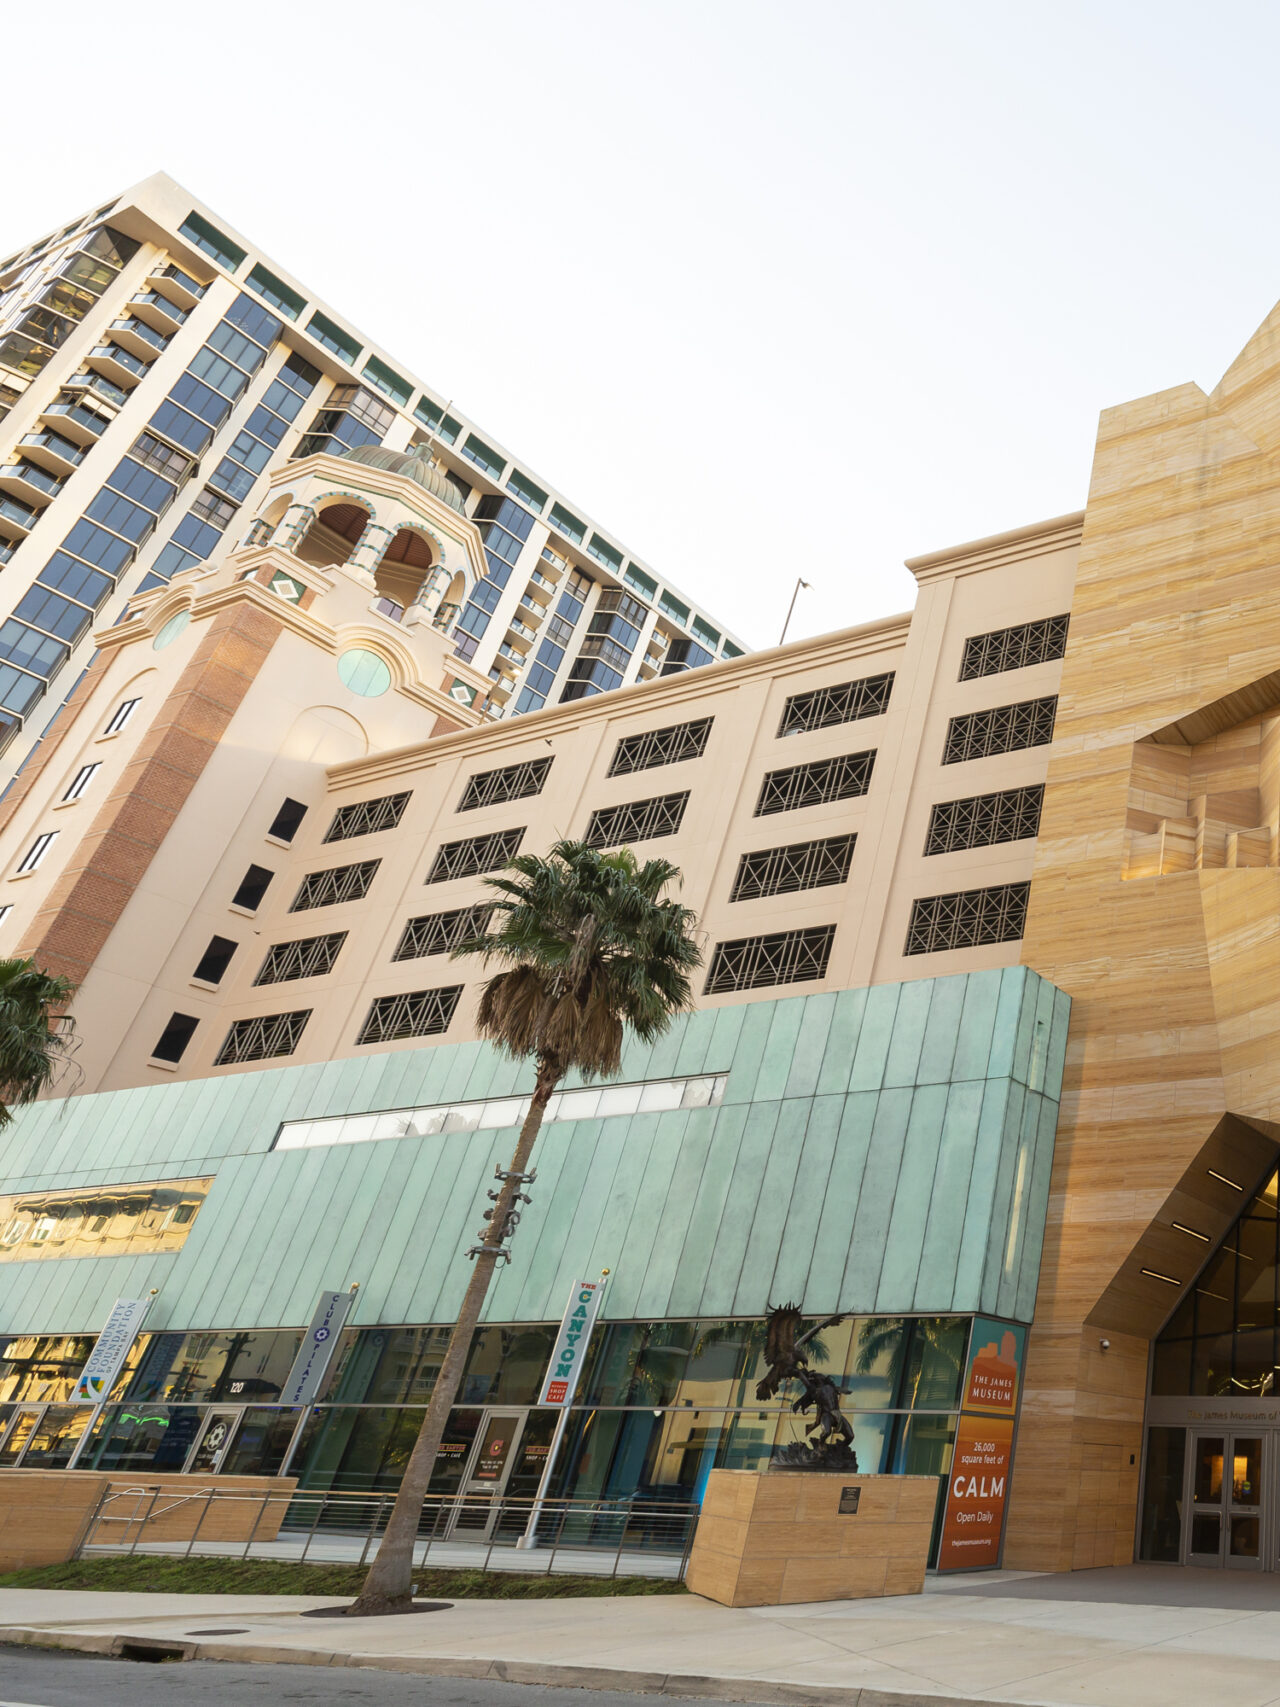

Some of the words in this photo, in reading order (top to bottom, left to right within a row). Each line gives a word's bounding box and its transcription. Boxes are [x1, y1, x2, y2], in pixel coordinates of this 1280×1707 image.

[323, 1295, 340, 1326] CLUB
[87, 1303, 125, 1373] COMMUNITY
[97, 1302, 136, 1373] FOUNDATION
[555, 1290, 592, 1377] CANYON
[293, 1343, 320, 1402] PILATES
[230, 1382, 244, 1393] 120
[974, 1374, 989, 1386] THE
[990, 1376, 1012, 1388] JAMES
[972, 1387, 1011, 1401] MUSEUM
[1204, 1410, 1228, 1421] James
[1230, 1410, 1266, 1420] Museum
[1268, 1410, 1277, 1420] of
[973, 1442, 995, 1454] 26,000
[961, 1455, 983, 1466] square
[983, 1454, 996, 1464] feet
[997, 1454, 1004, 1464] of
[953, 1476, 1004, 1498] CALM
[956, 1511, 976, 1524] Open
[976, 1510, 994, 1524] Daily
